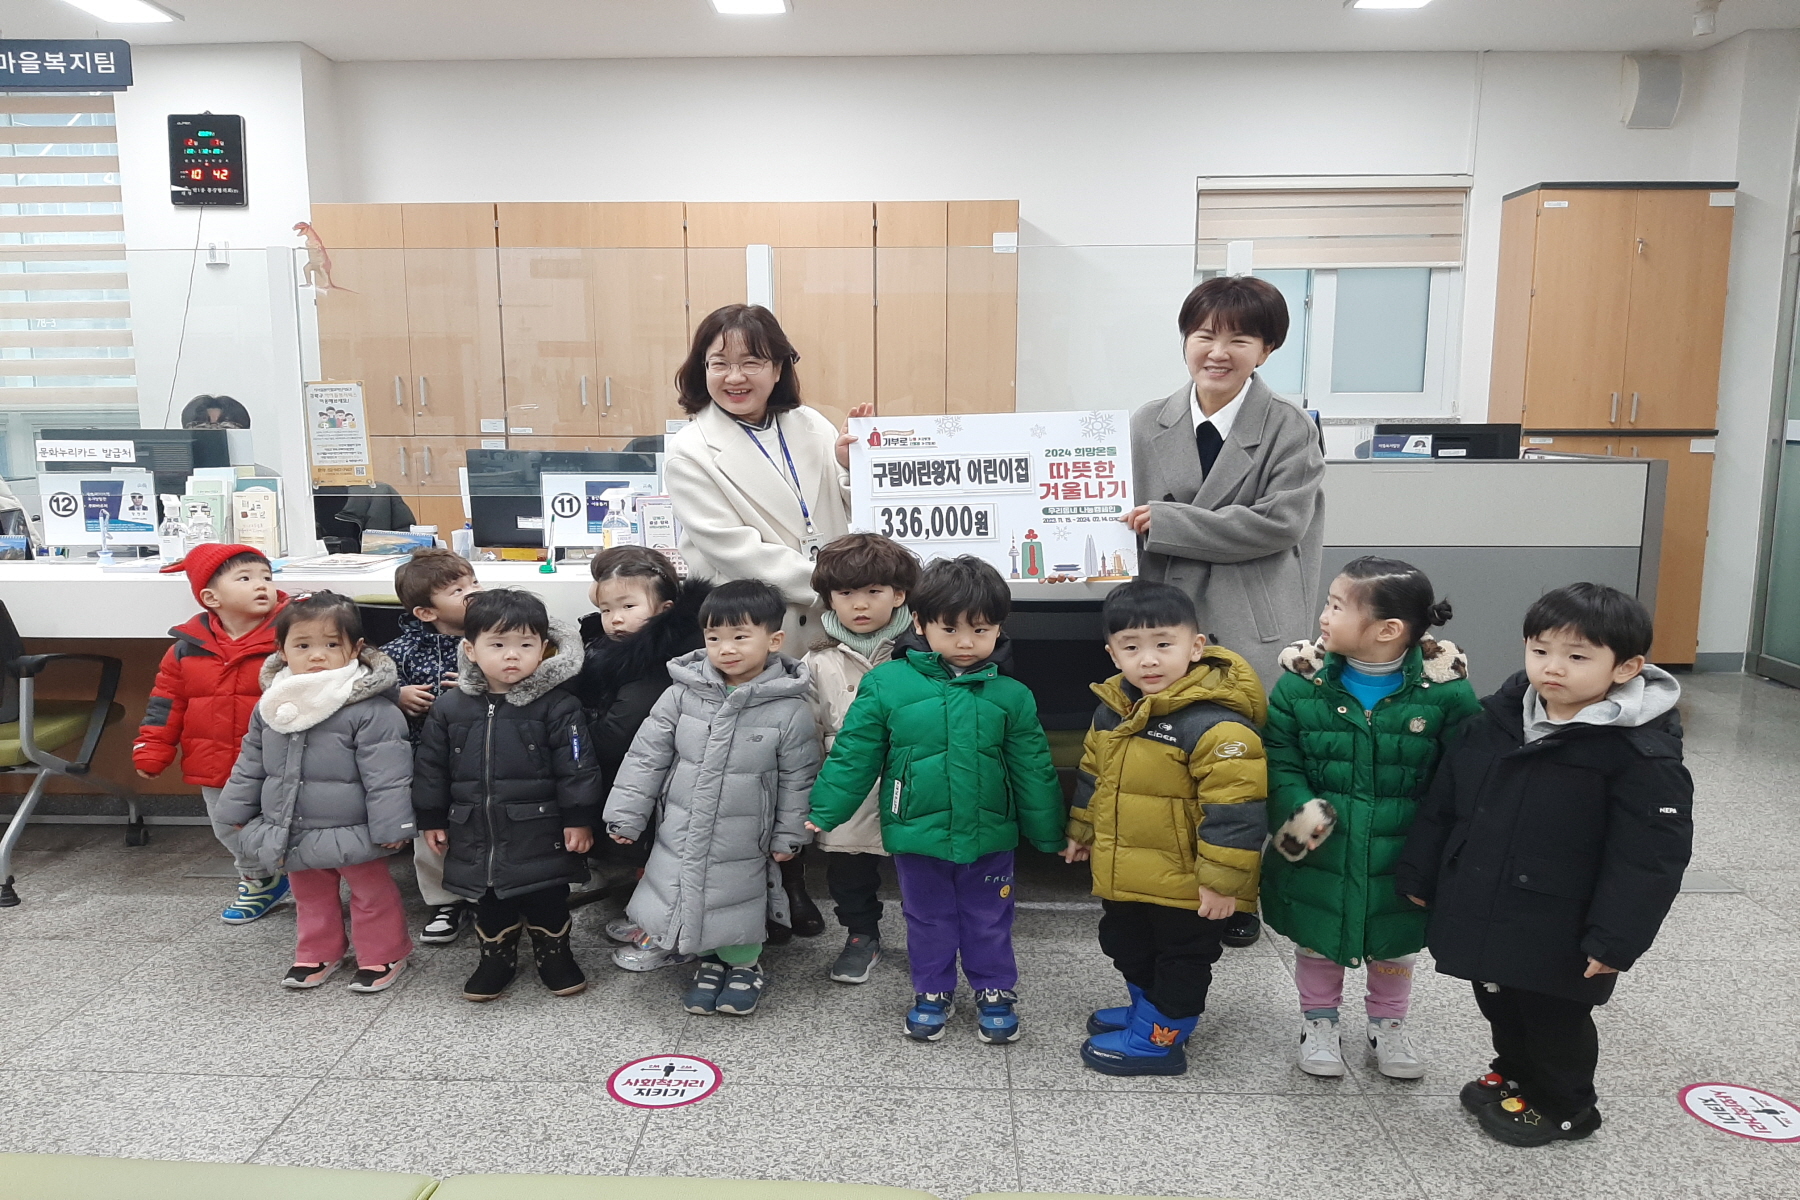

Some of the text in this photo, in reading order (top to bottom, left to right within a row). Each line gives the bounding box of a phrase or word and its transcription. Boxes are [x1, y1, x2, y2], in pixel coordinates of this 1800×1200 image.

[0, 51, 116, 74] 마을복지팀
[191, 169, 202, 180] 10
[212, 169, 229, 180] 42
[882, 437, 909, 447] 기부로
[38, 447, 132, 459] 문화누리카드 발급처
[1044, 448, 1072, 458] 2024
[872, 457, 1030, 488] 구립어린왕자 어린이집
[1049, 460, 1115, 480] 따뜻한
[1039, 480, 1126, 500] 겨울나기
[53, 496, 74, 512] 12
[557, 497, 574, 513] 11
[880, 505, 989, 540] 336,000원
[621, 1078, 705, 1088] 사회적거리
[633, 1088, 686, 1097] 지키기
[1697, 1097, 1741, 1124] 지키기
